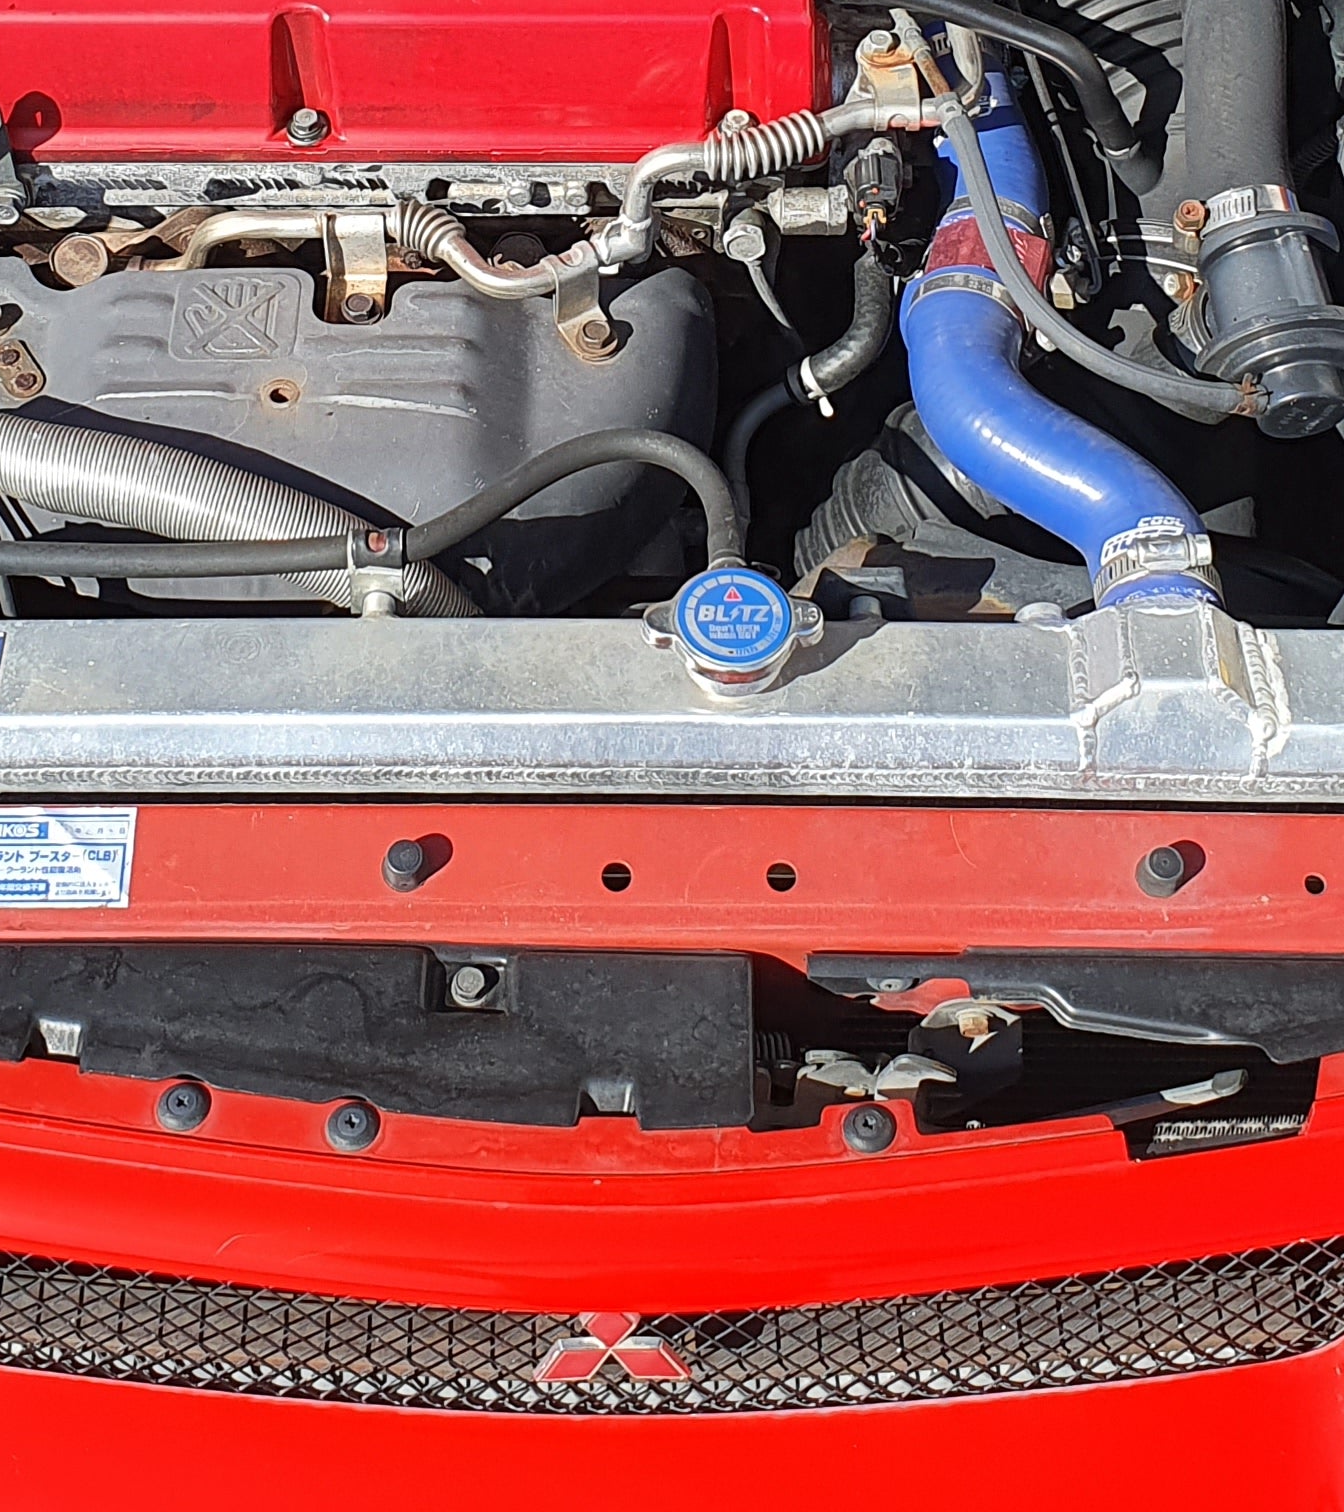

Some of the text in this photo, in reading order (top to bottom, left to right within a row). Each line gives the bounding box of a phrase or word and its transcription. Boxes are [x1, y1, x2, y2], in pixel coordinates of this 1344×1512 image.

[1138, 516, 1186, 529] COOL
[698, 605, 771, 622] BLITZ
[795, 607, 819, 622] 1.3
[709, 624, 734, 632] Don't
[29, 849, 80, 863] ブースター
